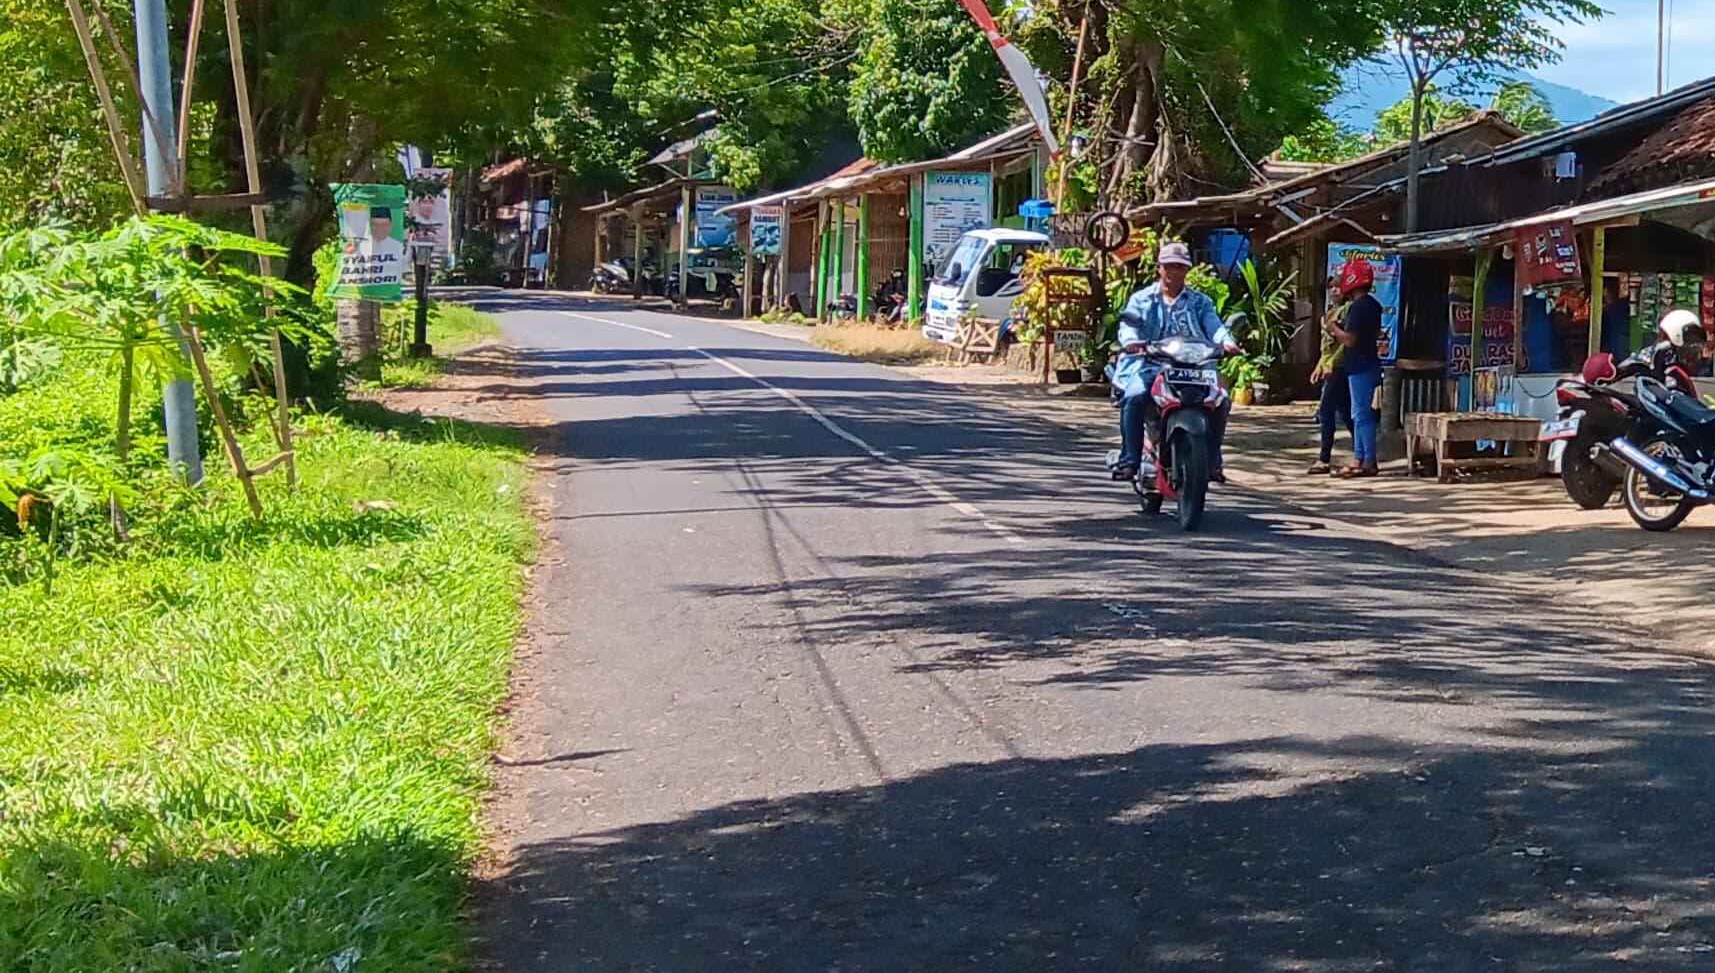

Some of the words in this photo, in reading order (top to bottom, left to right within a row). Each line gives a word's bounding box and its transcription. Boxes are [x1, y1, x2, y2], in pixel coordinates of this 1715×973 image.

[342, 253, 398, 265] SYAIFUL
[341, 265, 384, 275] BAHRI
[337, 275, 398, 285] ANSHORI
[1487, 343, 1524, 359] RAS
